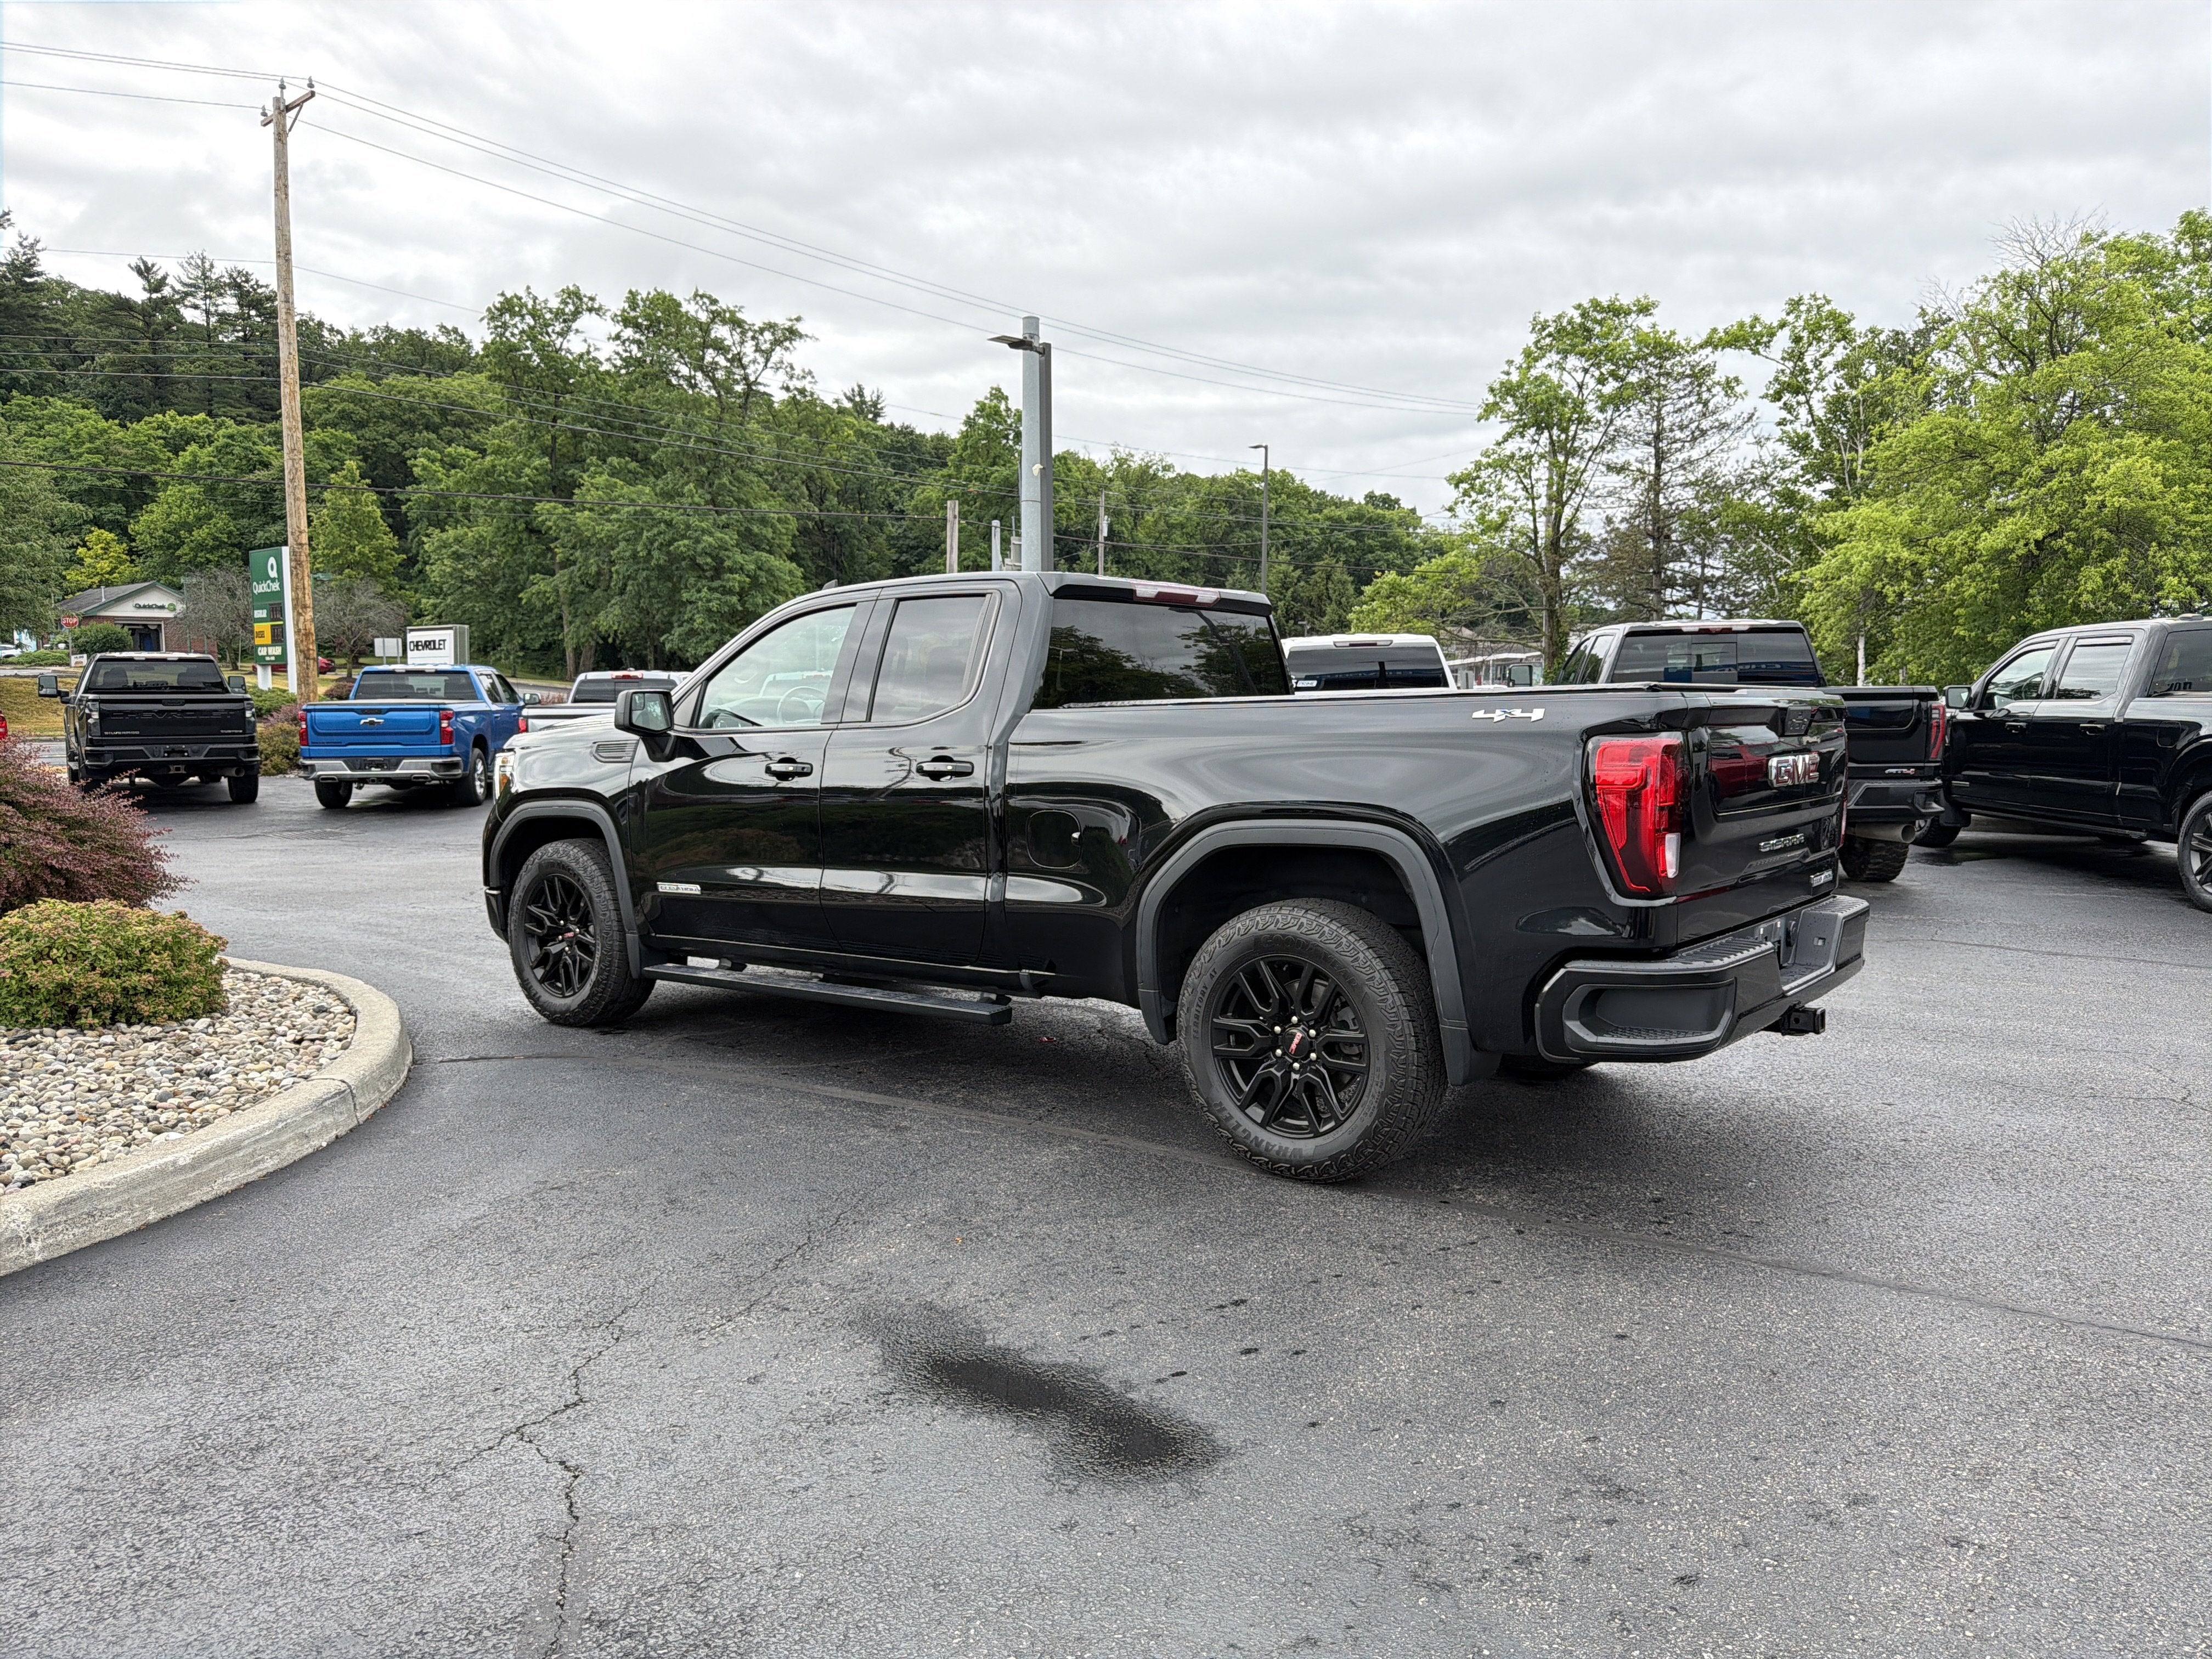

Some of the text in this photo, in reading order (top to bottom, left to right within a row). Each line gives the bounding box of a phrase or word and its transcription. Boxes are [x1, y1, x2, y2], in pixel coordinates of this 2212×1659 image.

[253, 579, 281, 595] QuickChek
[257, 646, 282, 656] CAR WASH
[409, 639, 447, 651] CHEVROLET
[1768, 752, 1820, 787] GMC
[1758, 833, 1804, 852] SIERRA
[1193, 967, 1217, 1040] TERRITORY AT
[1212, 1101, 1304, 1159] WRANGLER
